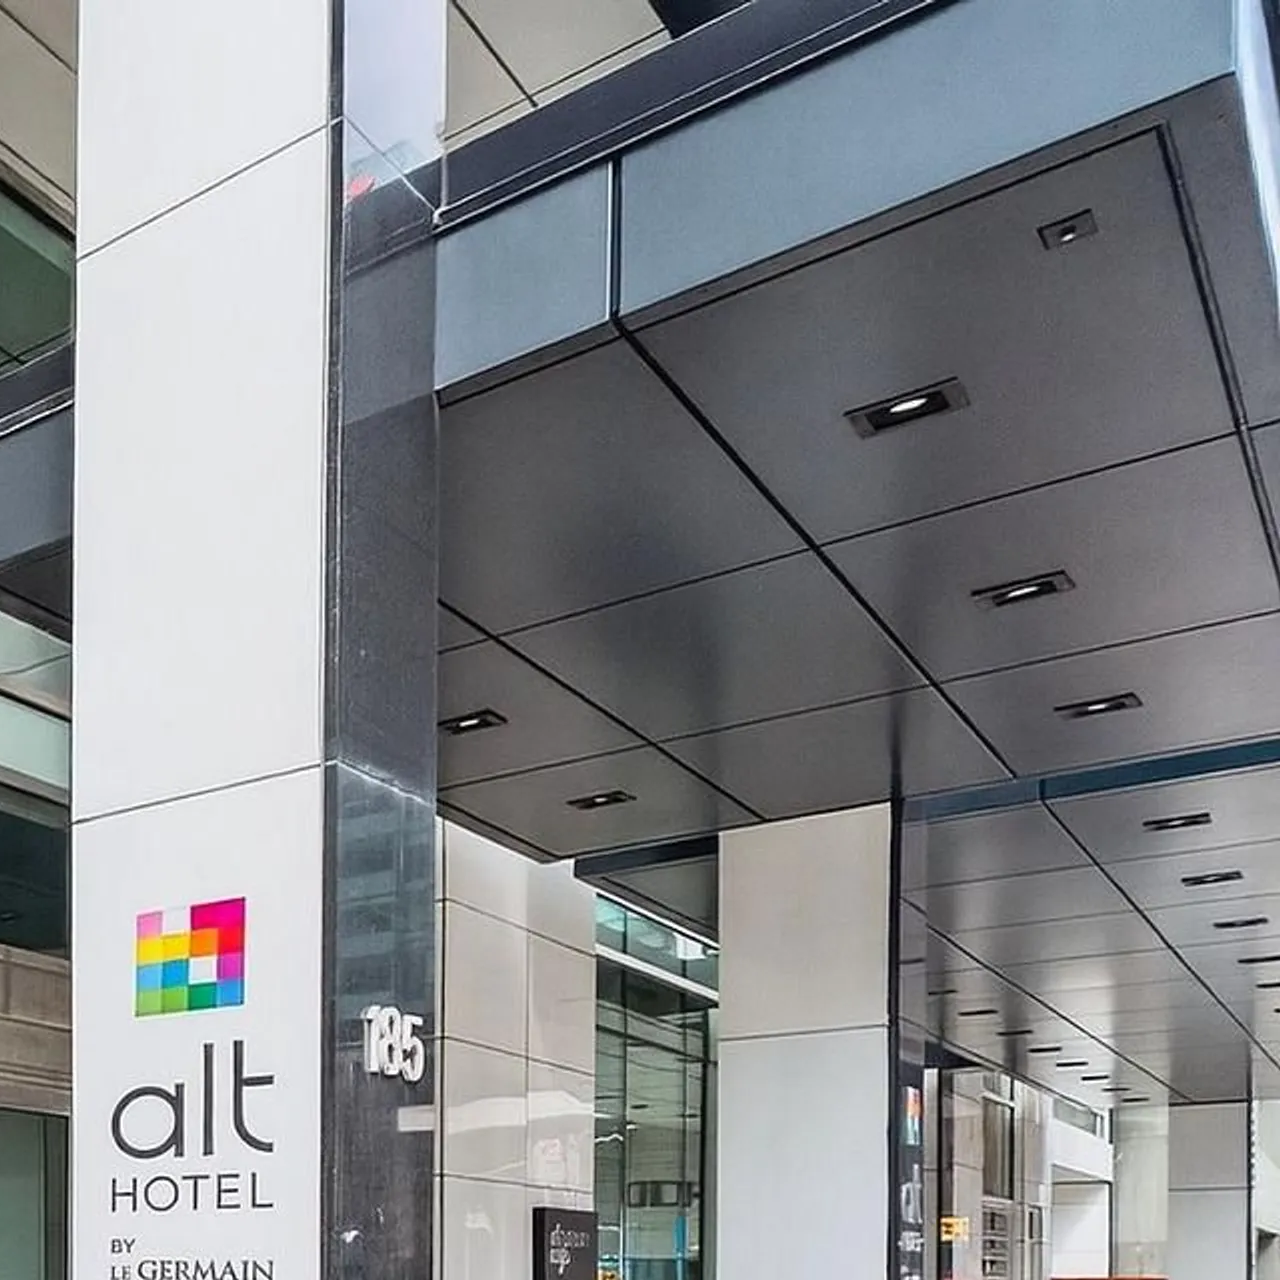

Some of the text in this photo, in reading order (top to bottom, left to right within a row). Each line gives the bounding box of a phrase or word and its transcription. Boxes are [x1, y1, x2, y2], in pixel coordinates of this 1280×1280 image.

[362, 1005, 425, 1082] 185
[111, 1039, 275, 1159] alt
[111, 1171, 274, 1213] HOTEL
[111, 1238, 136, 1254] BY
[110, 1265, 132, 1280] LE
